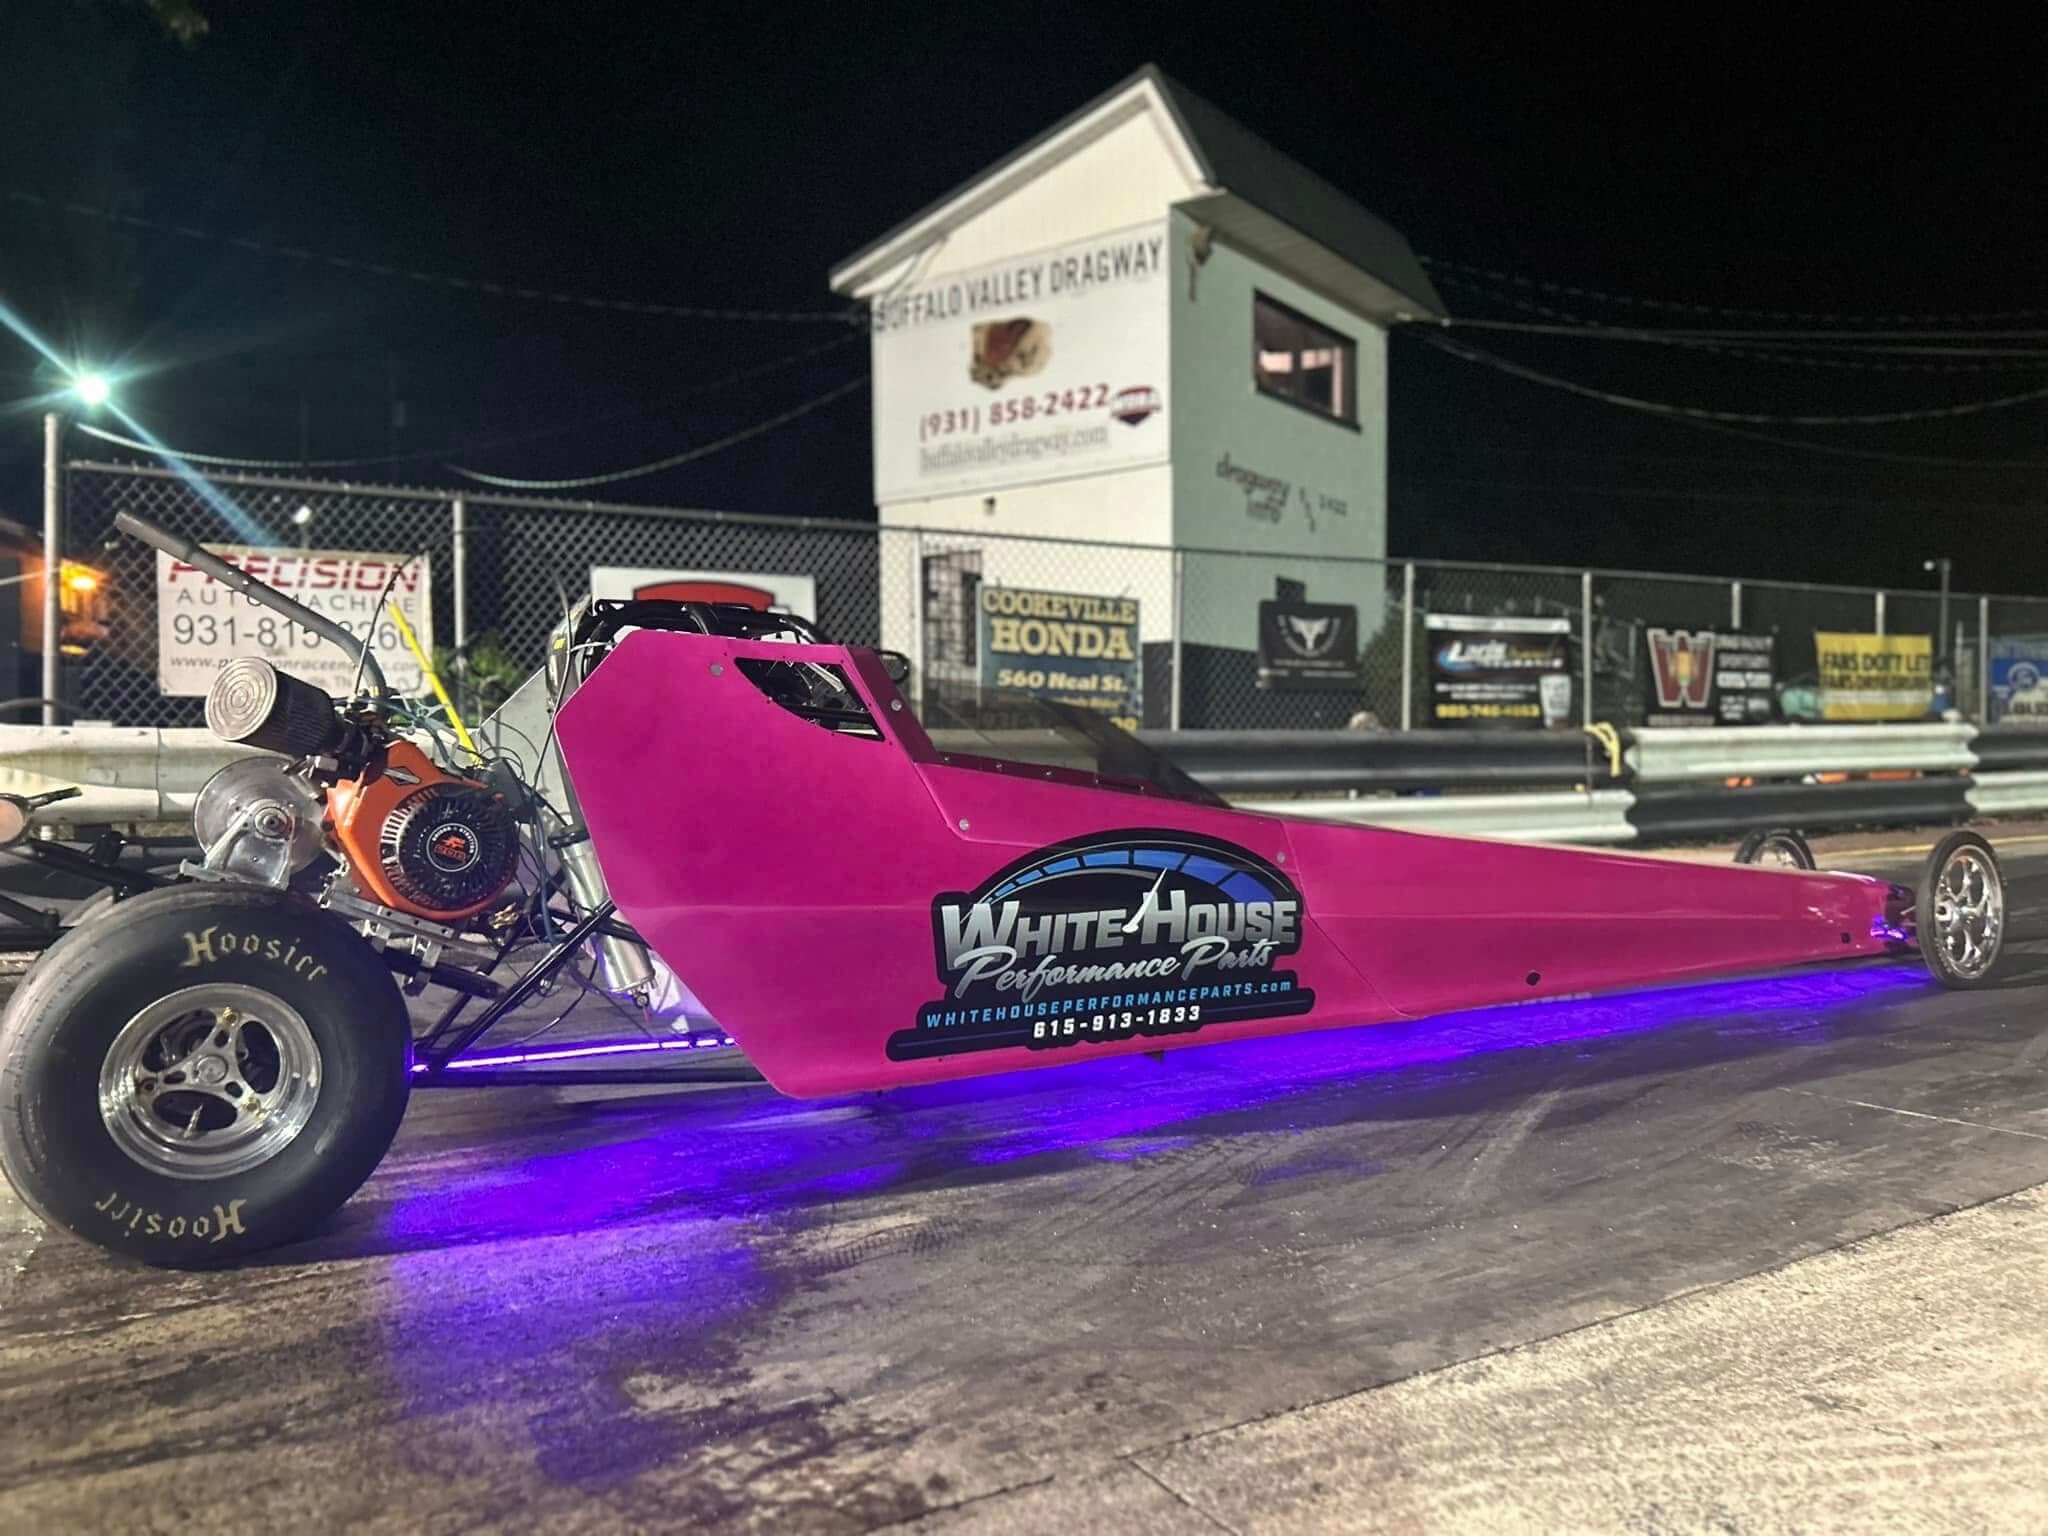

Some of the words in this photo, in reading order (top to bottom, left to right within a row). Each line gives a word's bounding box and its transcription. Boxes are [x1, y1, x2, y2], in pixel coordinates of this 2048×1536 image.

[967, 264, 1044, 310] VALLEY
[1050, 238, 1163, 292] DRAGWAY
[919, 407, 980, 442] (931)
[989, 382, 1110, 426] 858-2422
[288, 593, 416, 613] ACHIE
[983, 590, 1136, 623] COOKEVILLE
[991, 618, 1135, 660] HONDA
[998, 669, 1045, 688] 560
[1048, 672, 1099, 691] Neal
[1101, 675, 1128, 692] St.
[941, 900, 1126, 970] WHITE
[1140, 889, 1297, 945] HOUSE
[943, 945, 1181, 1001] Performance
[1180, 935, 1280, 981] Parts
[927, 979, 1292, 1028] WHITEHOUSEPERFORMANCEPARTS.com
[1033, 1005, 1200, 1038] 615-913-1833
